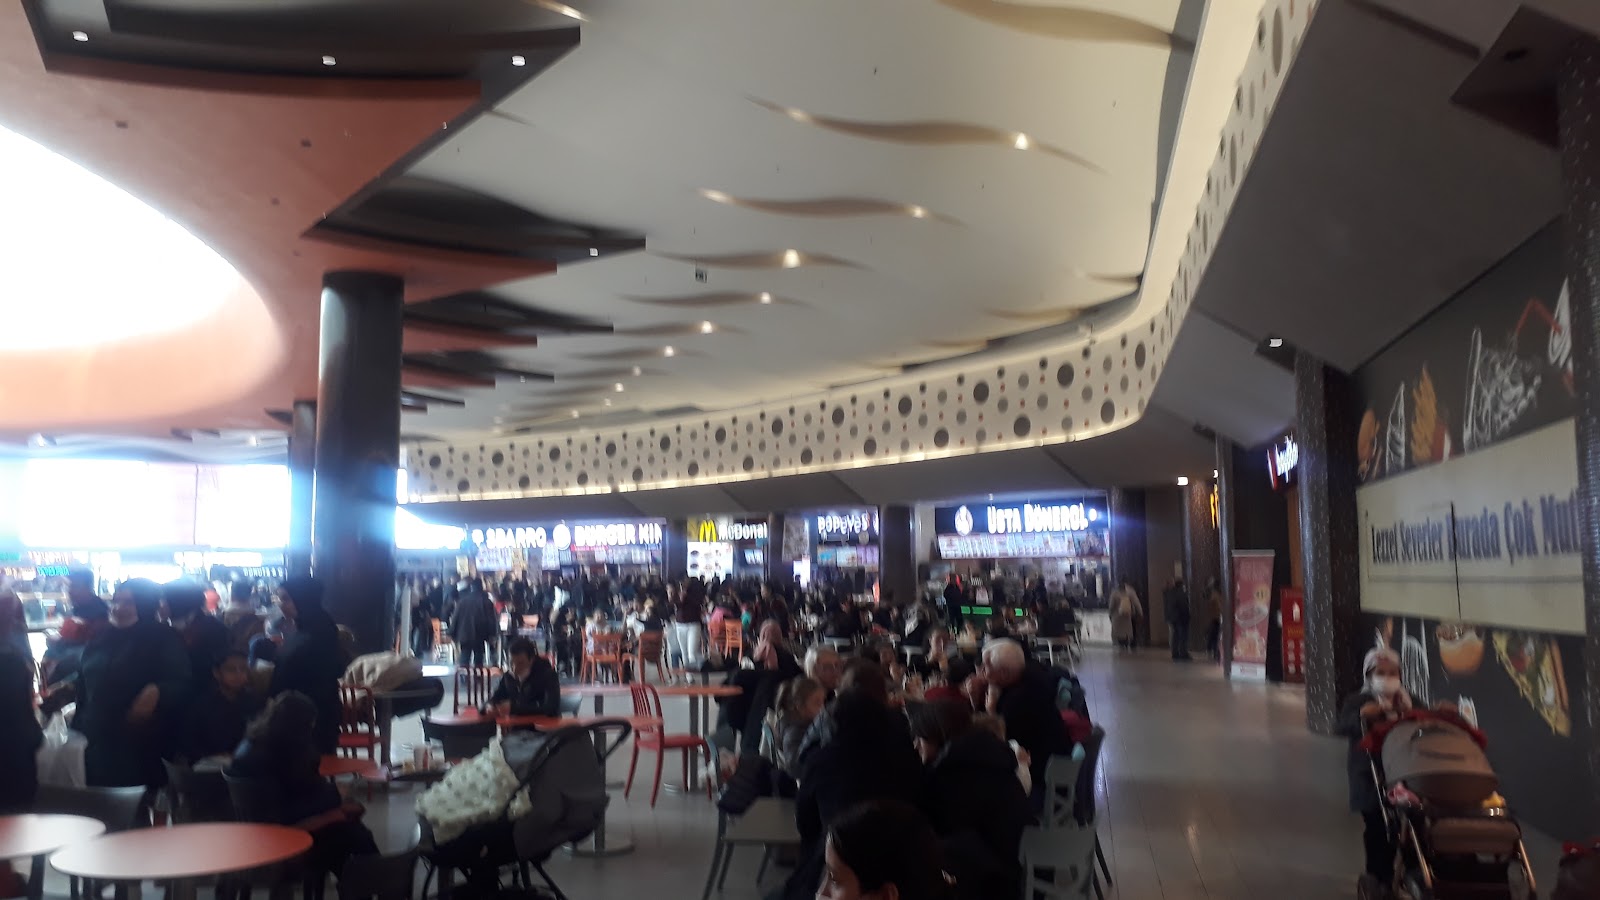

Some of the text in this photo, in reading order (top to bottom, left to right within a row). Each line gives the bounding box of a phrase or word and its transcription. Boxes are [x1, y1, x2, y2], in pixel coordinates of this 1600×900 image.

[987, 505, 1022, 534] USTA
[1503, 496, 1539, 566] Çok
[574, 523, 636, 547] BURGER
